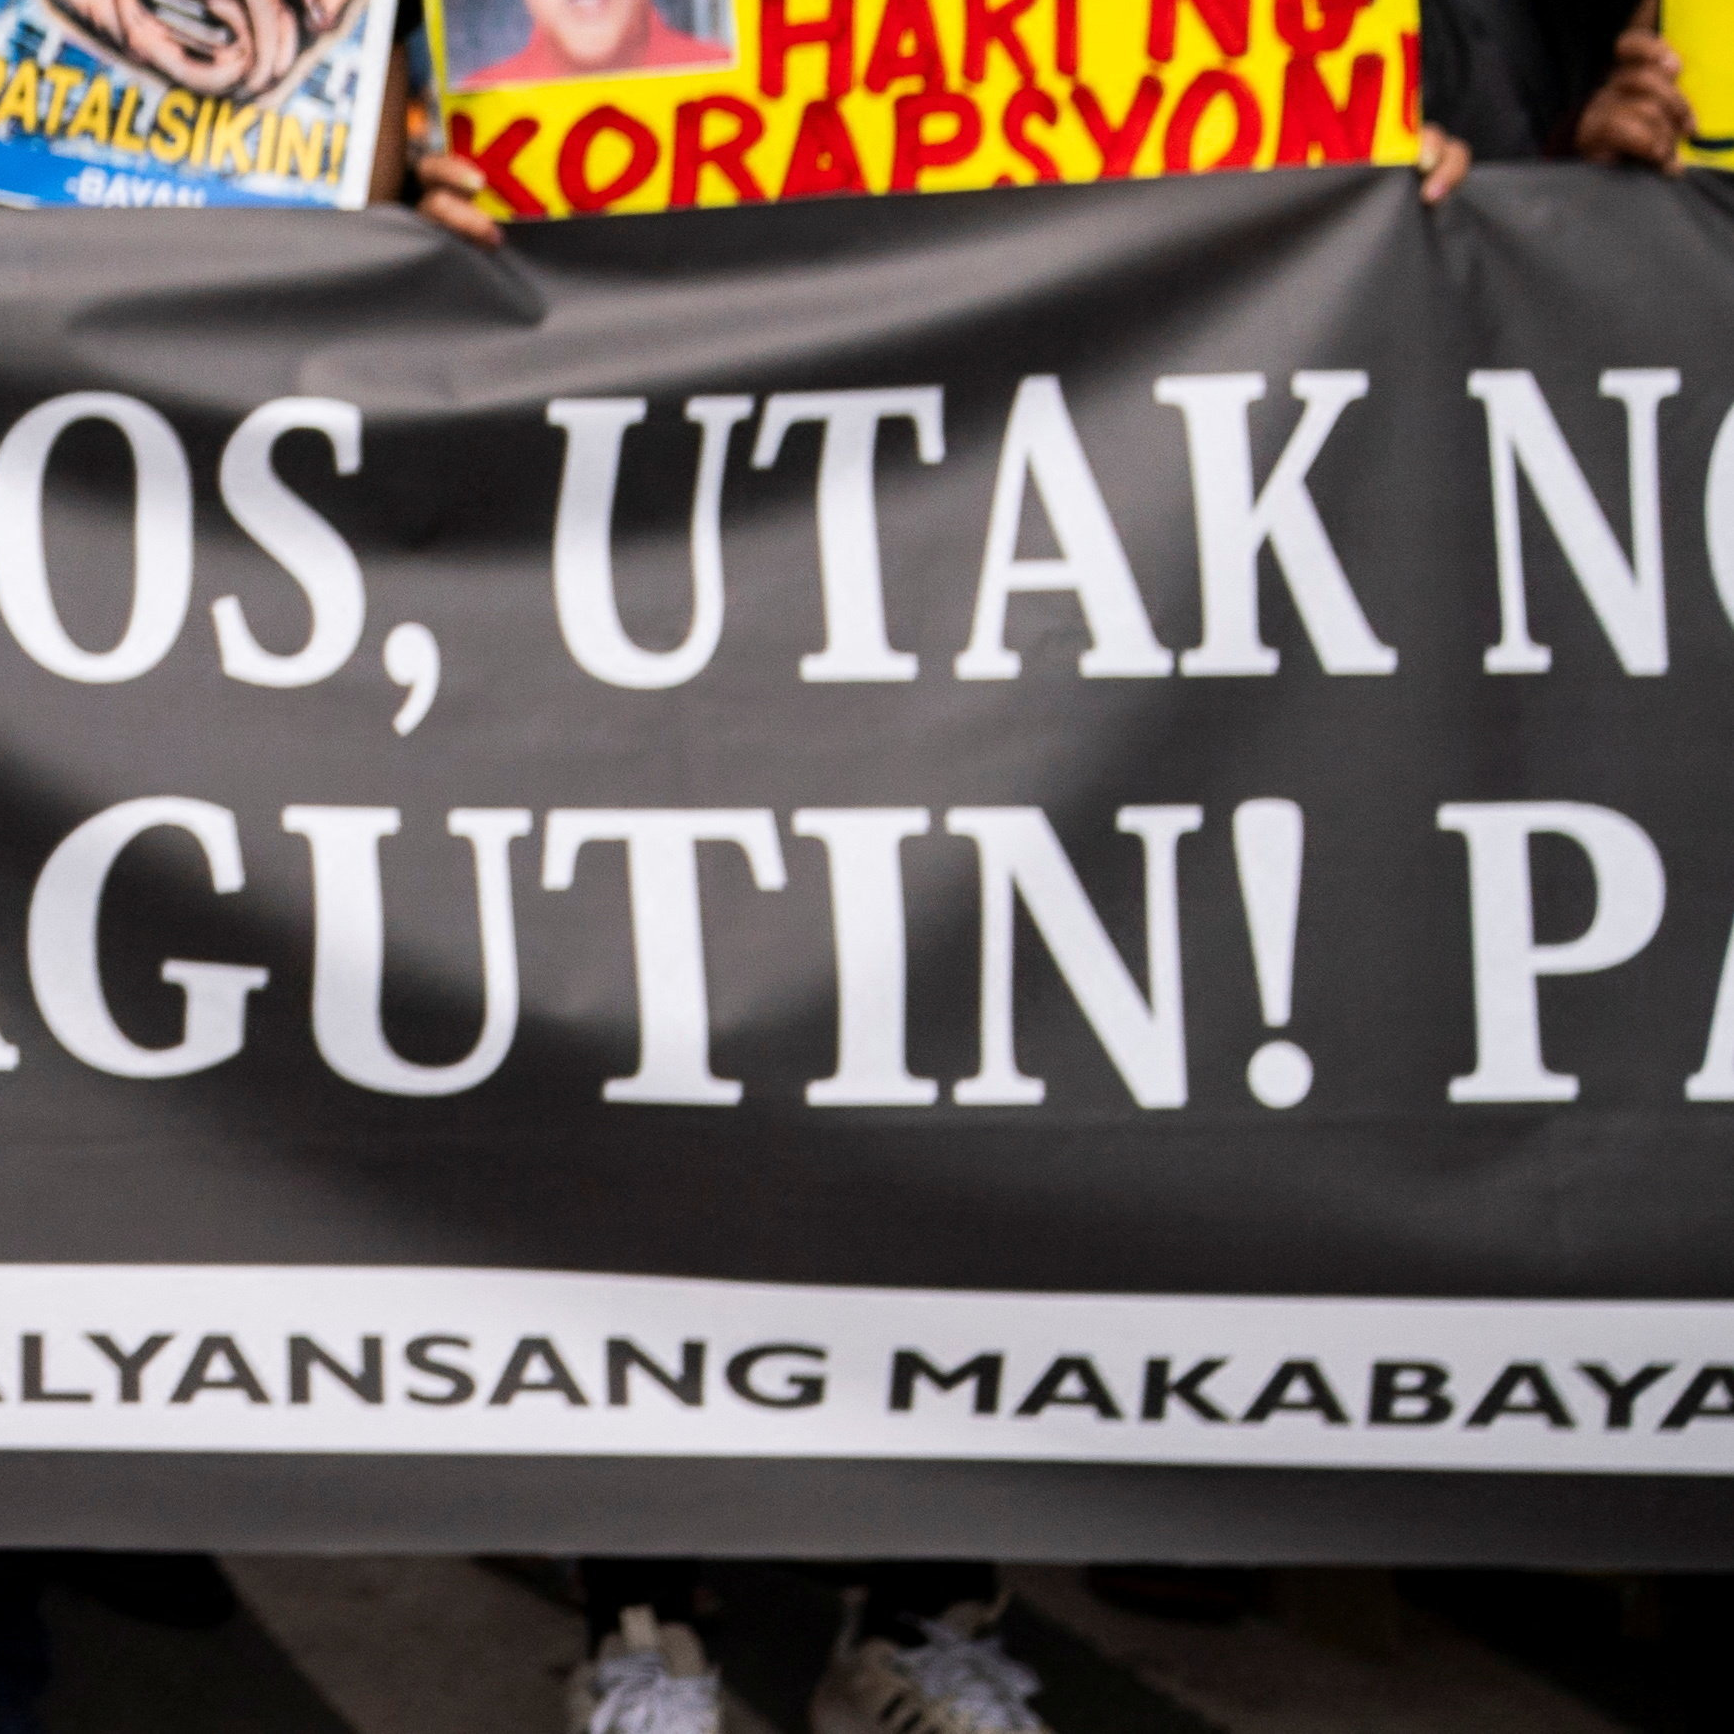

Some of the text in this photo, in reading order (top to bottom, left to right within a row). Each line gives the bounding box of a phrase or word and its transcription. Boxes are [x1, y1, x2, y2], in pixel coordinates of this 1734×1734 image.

[545, 370, 1398, 690] UTAK
[1468, 367, 1734, 677] N
[1436, 798, 1734, 1103] P
